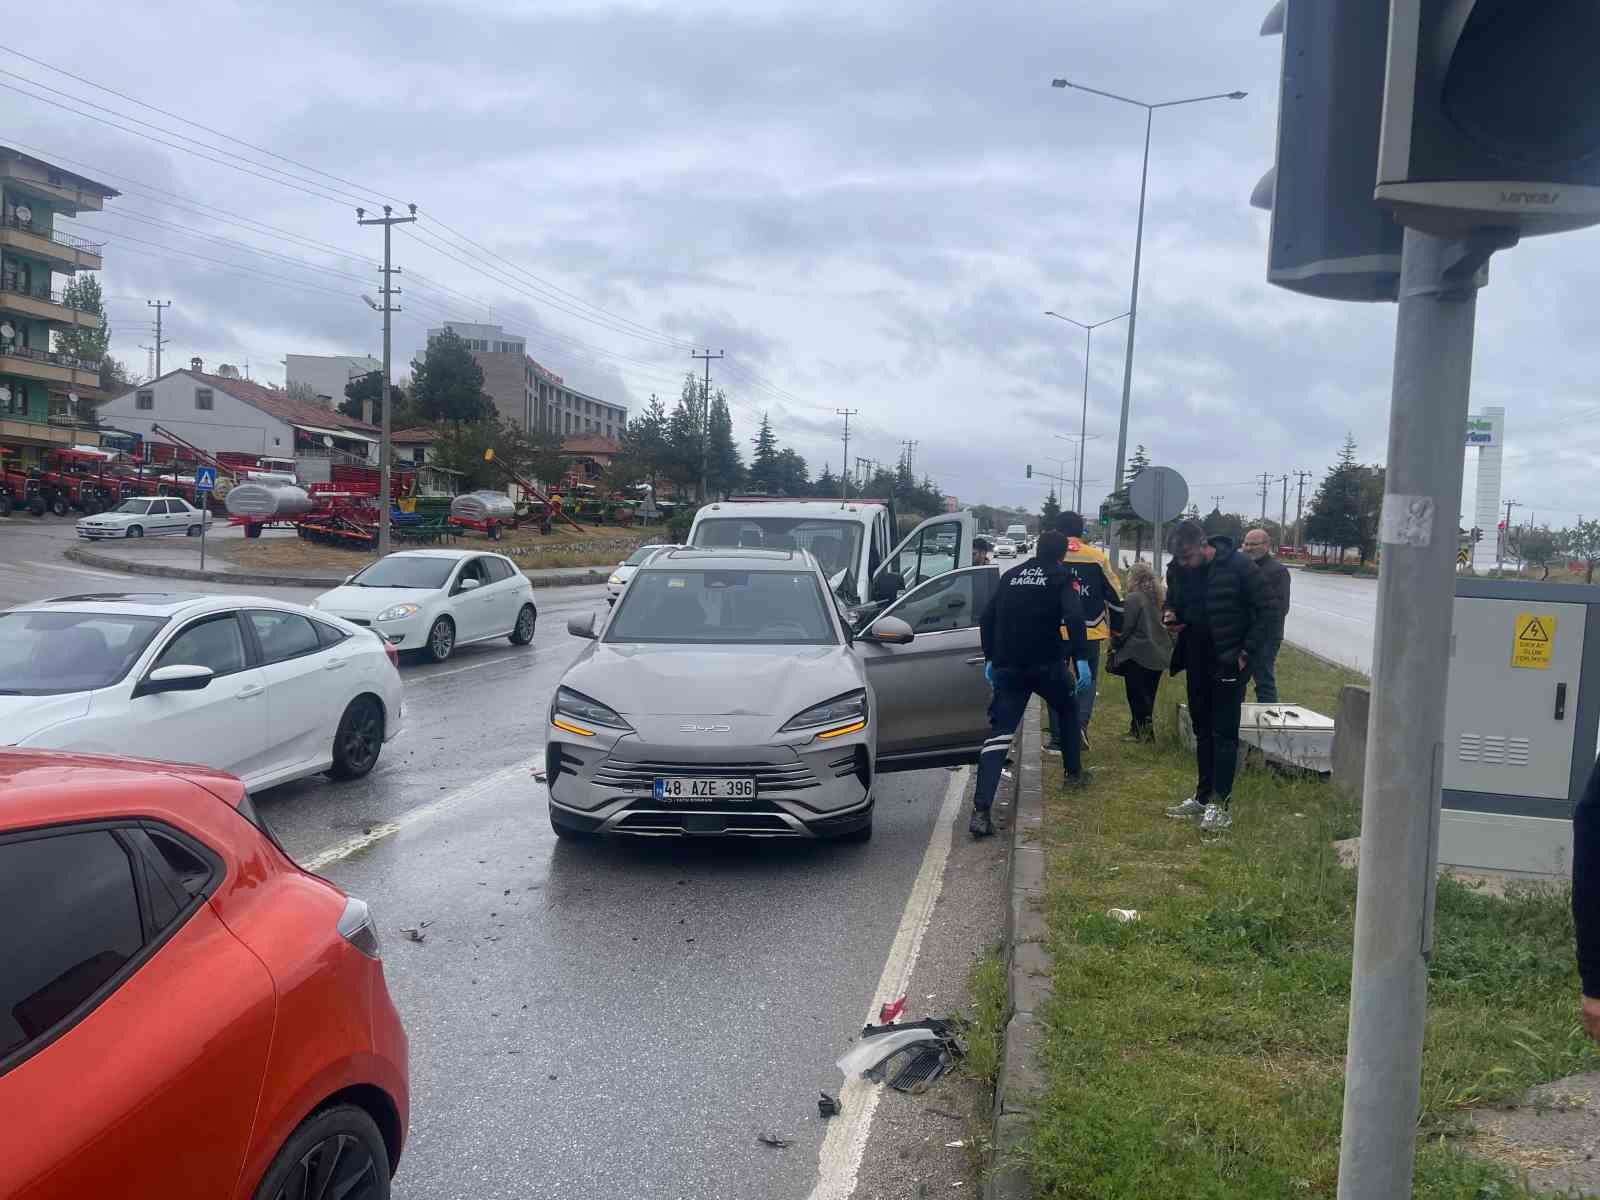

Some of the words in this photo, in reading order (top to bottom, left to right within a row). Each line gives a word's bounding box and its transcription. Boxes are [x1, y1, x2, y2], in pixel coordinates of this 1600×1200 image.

[1010, 576, 1048, 586] SAĞLIK
[665, 780, 682, 796] 48
[691, 780, 717, 796] AZE
[726, 780, 753, 796] 396
